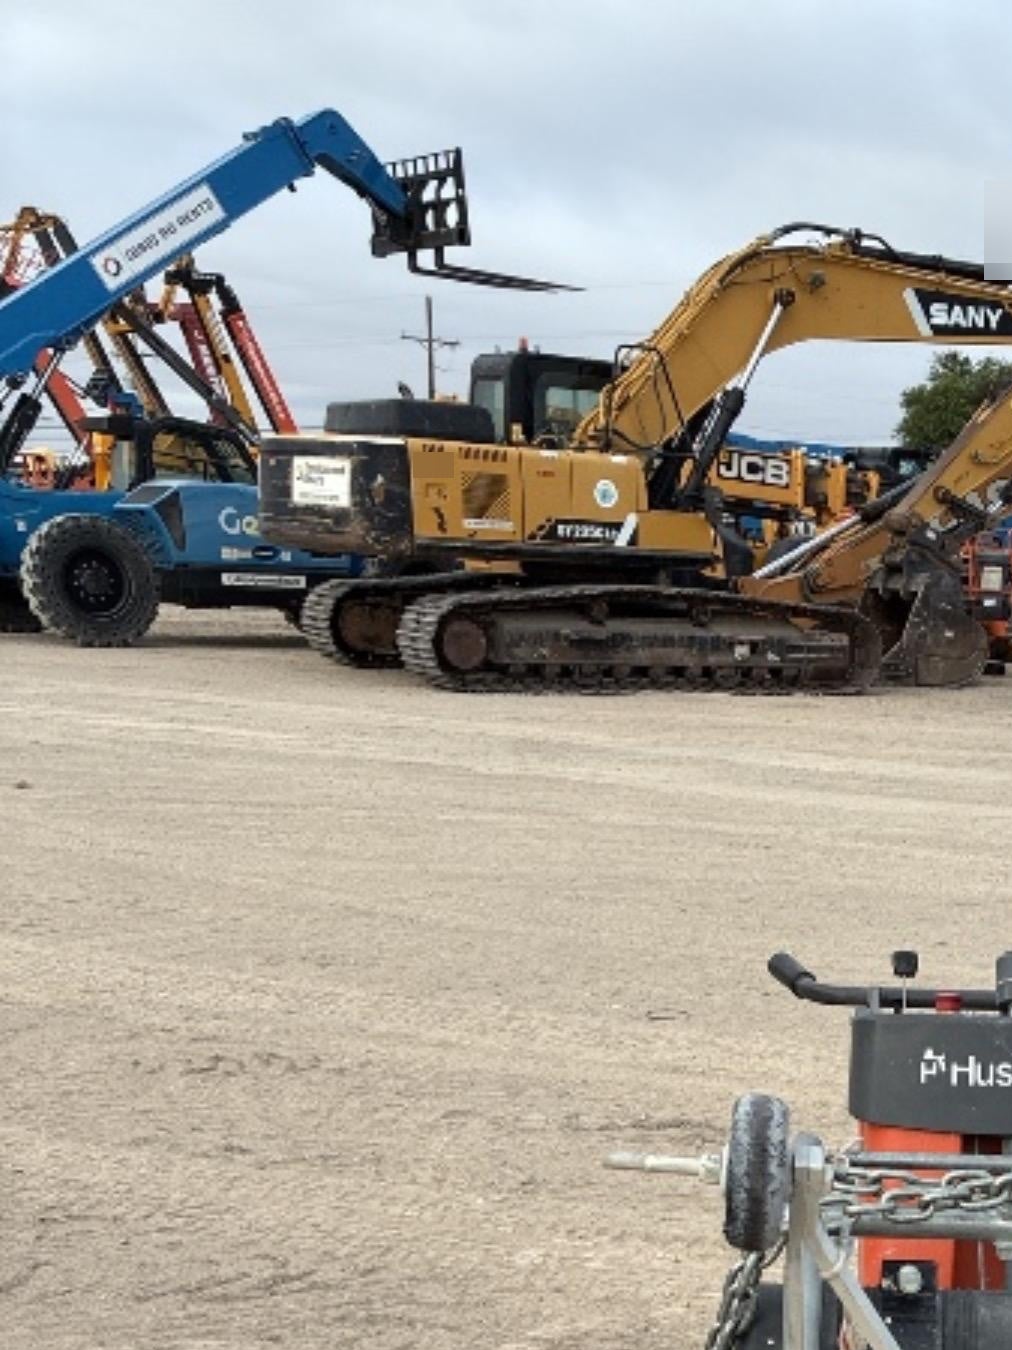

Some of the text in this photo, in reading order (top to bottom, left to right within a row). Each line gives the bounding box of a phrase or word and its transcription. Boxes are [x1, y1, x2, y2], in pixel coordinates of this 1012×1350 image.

[929, 302, 1003, 331] SANY
[719, 452, 790, 487] JCB
[217, 506, 261, 538] Ge
